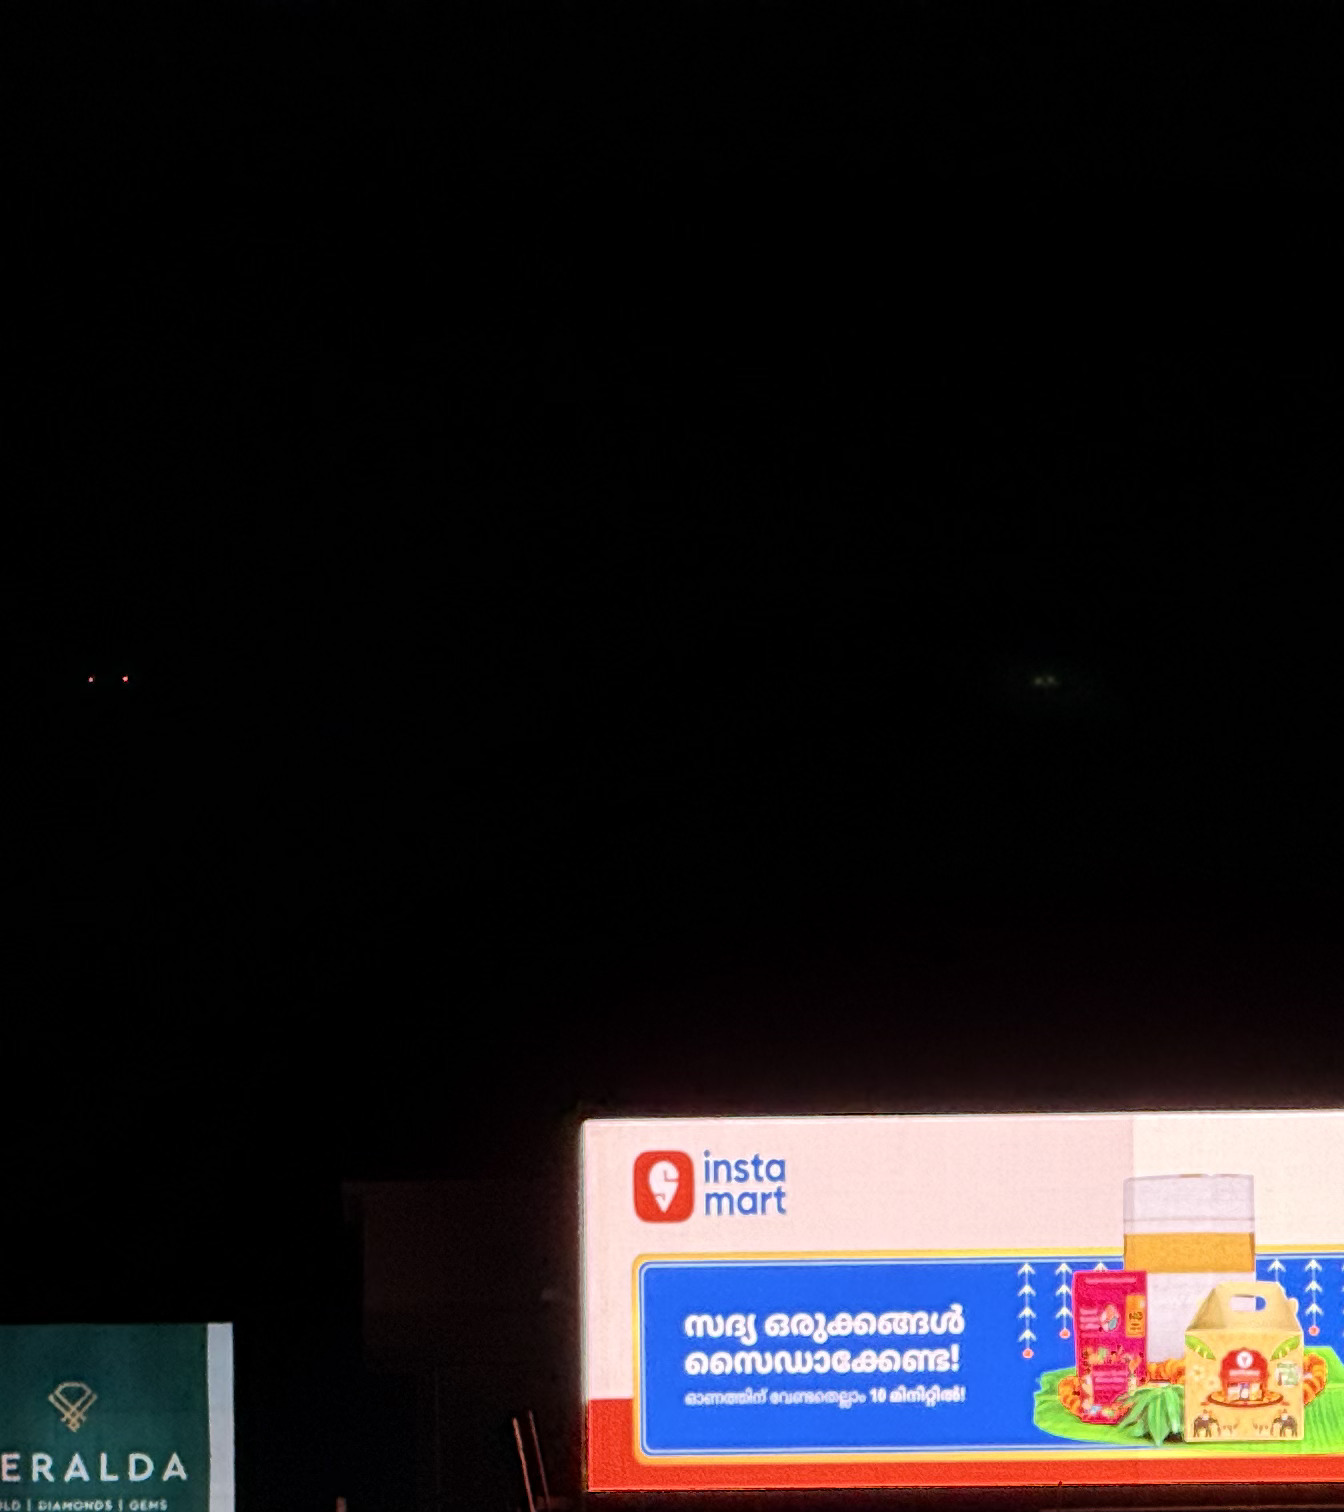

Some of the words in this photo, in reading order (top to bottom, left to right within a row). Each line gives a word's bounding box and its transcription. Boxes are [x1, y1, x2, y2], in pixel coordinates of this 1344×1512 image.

[703, 1149, 786, 1183] insta
[705, 1186, 787, 1216] mart
[684, 1313, 757, 1346] സദ്യ
[764, 1303, 965, 1344] ഒരുക്കങ്ങൾ
[684, 1343, 960, 1375] സൈഡാക്കേണ്ട!
[870, 1388, 887, 1402] 10
[37, 1499, 113, 1512] DIAMONDS
[128, 1499, 168, 1512] GEMS
